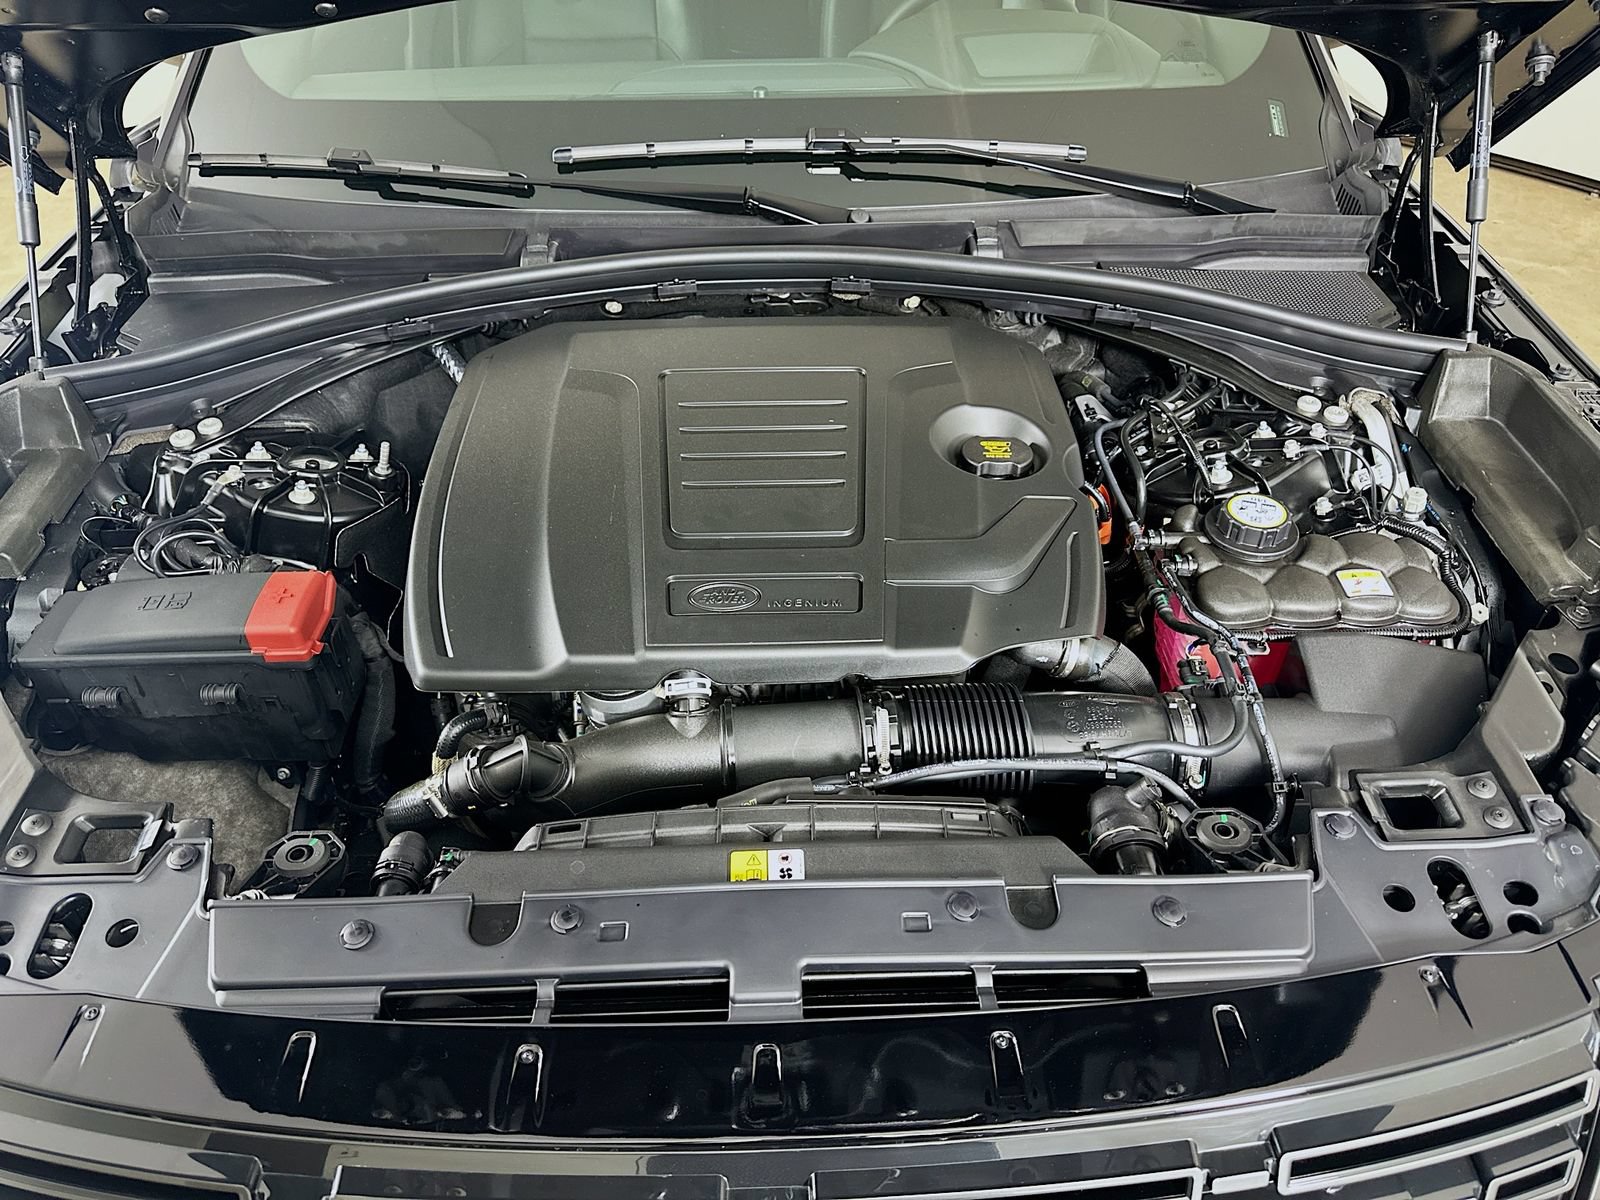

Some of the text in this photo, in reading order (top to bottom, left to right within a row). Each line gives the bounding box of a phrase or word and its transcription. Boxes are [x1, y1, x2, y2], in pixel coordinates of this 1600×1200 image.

[703, 588, 737, 596] LAND
[705, 596, 747, 605] ROVER
[766, 598, 843, 608] INGENIUM
